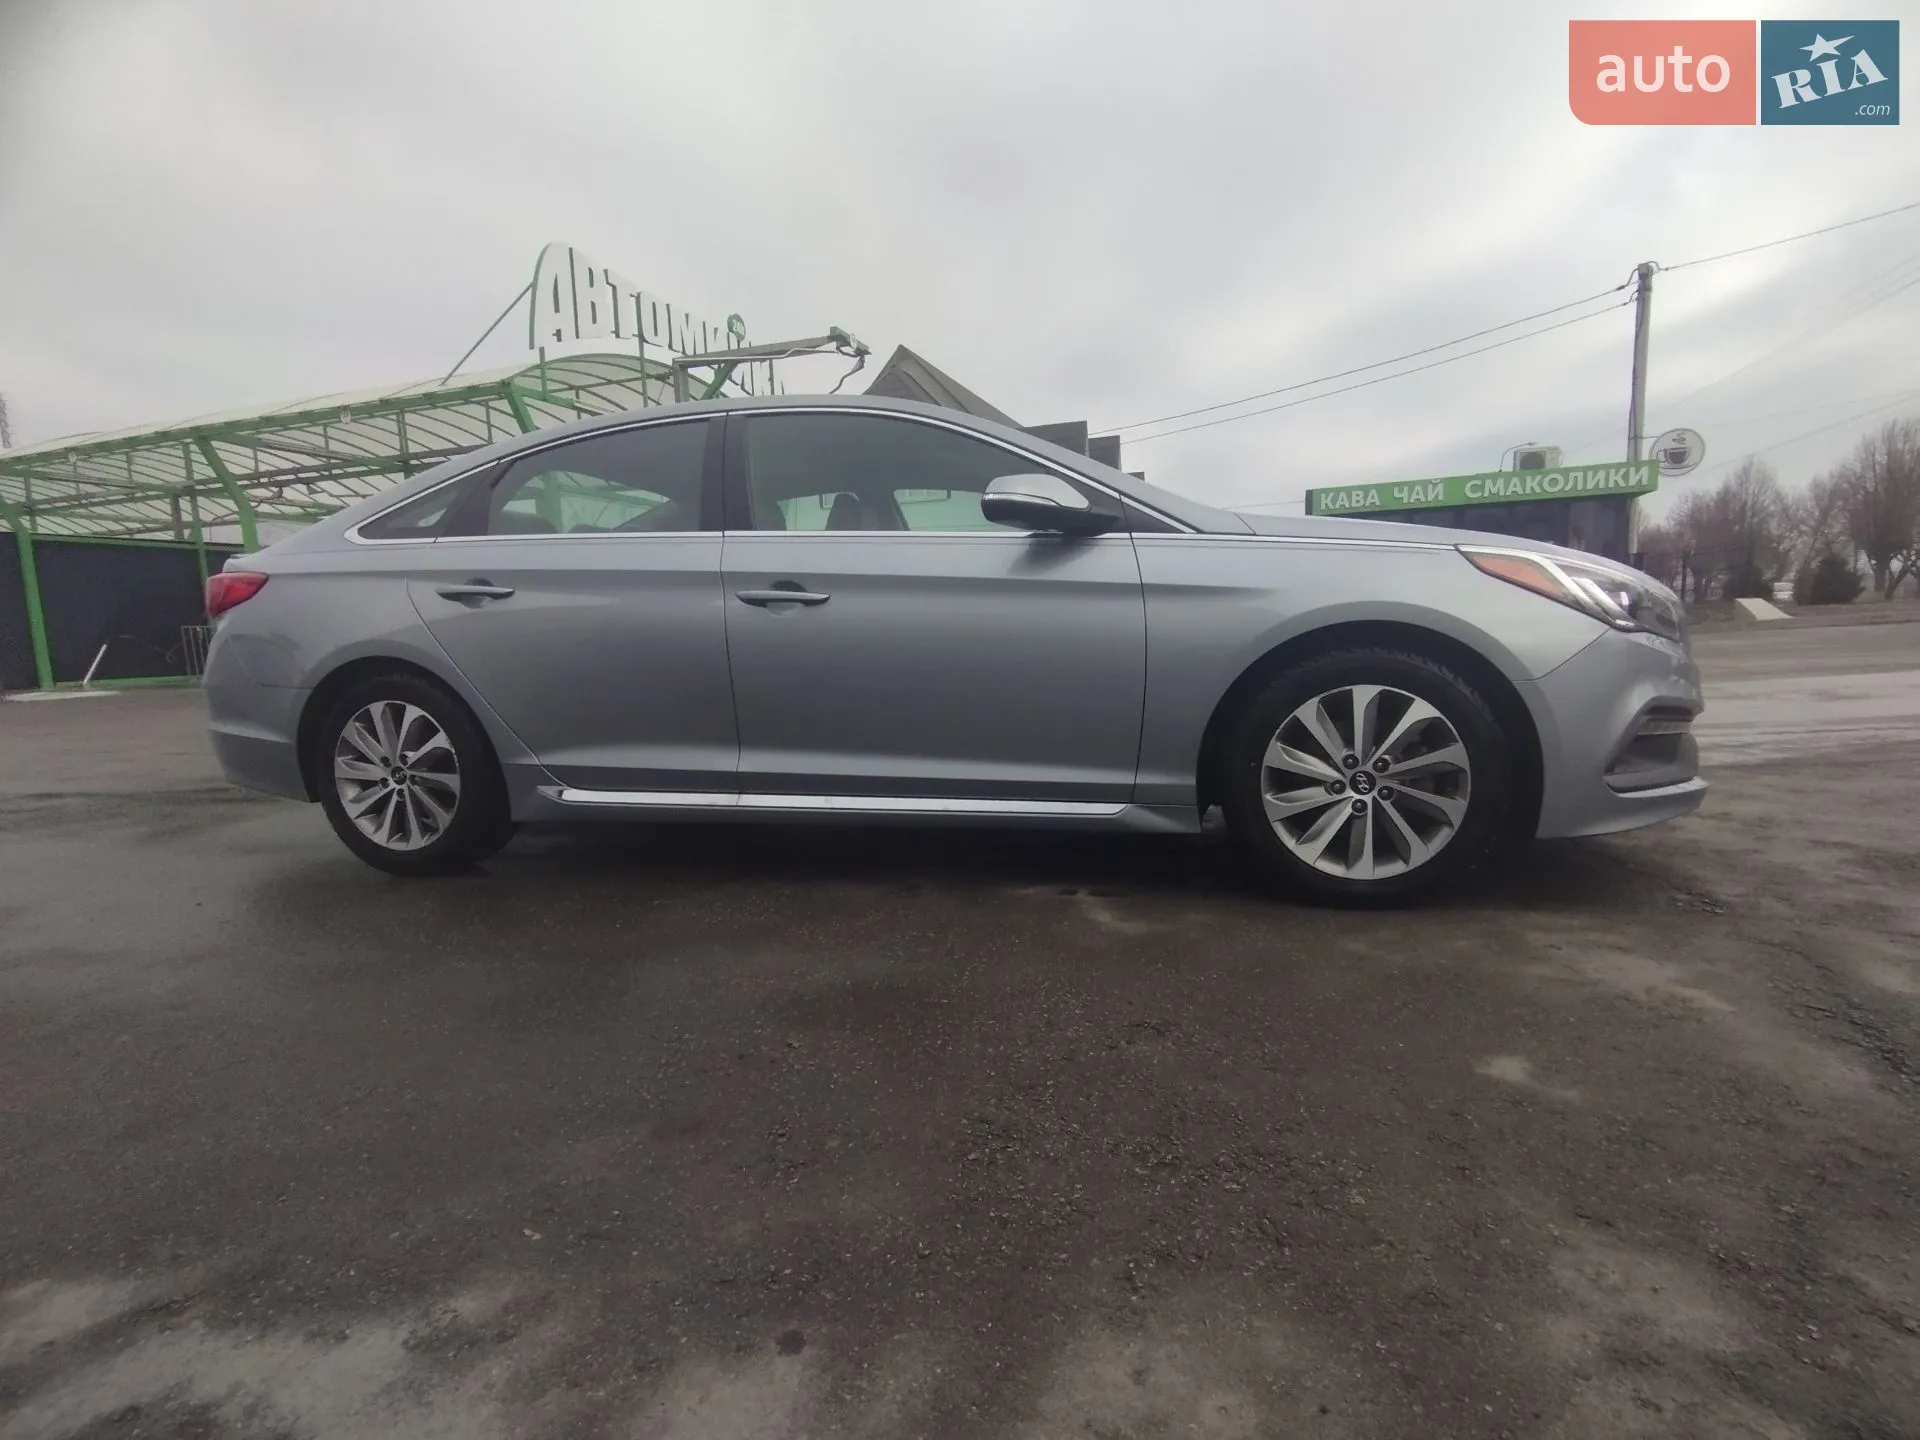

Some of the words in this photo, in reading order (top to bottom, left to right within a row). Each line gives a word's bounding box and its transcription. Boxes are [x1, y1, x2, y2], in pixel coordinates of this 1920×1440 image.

[1320, 488, 1381, 511] КАВА
[1393, 478, 1444, 504] ЧАЙ
[1463, 465, 1650, 499] СМАКОЛИКИ
